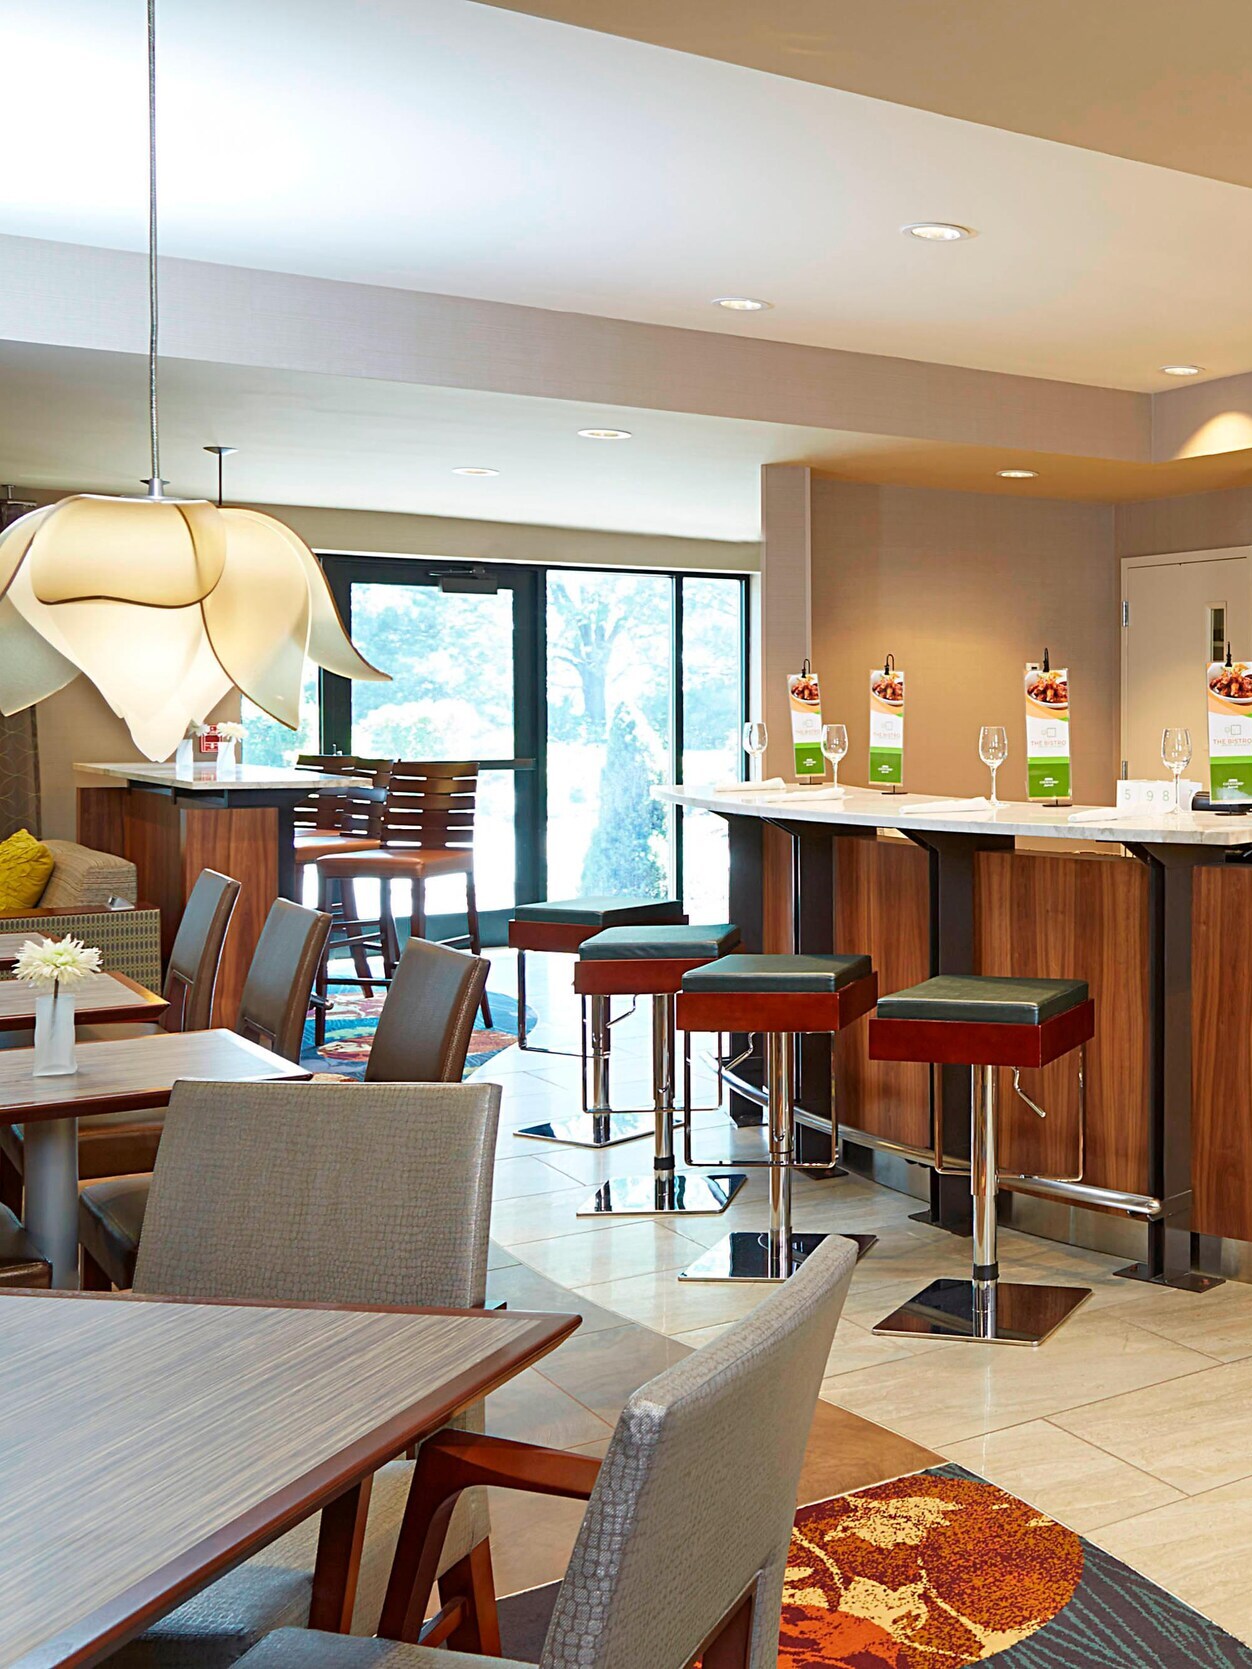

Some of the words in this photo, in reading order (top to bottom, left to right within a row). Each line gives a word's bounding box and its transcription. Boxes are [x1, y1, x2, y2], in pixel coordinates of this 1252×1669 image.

[1124, 789, 1131, 800] 5
[1146, 790, 1154, 802] 9
[1162, 790, 1170, 802] 8
